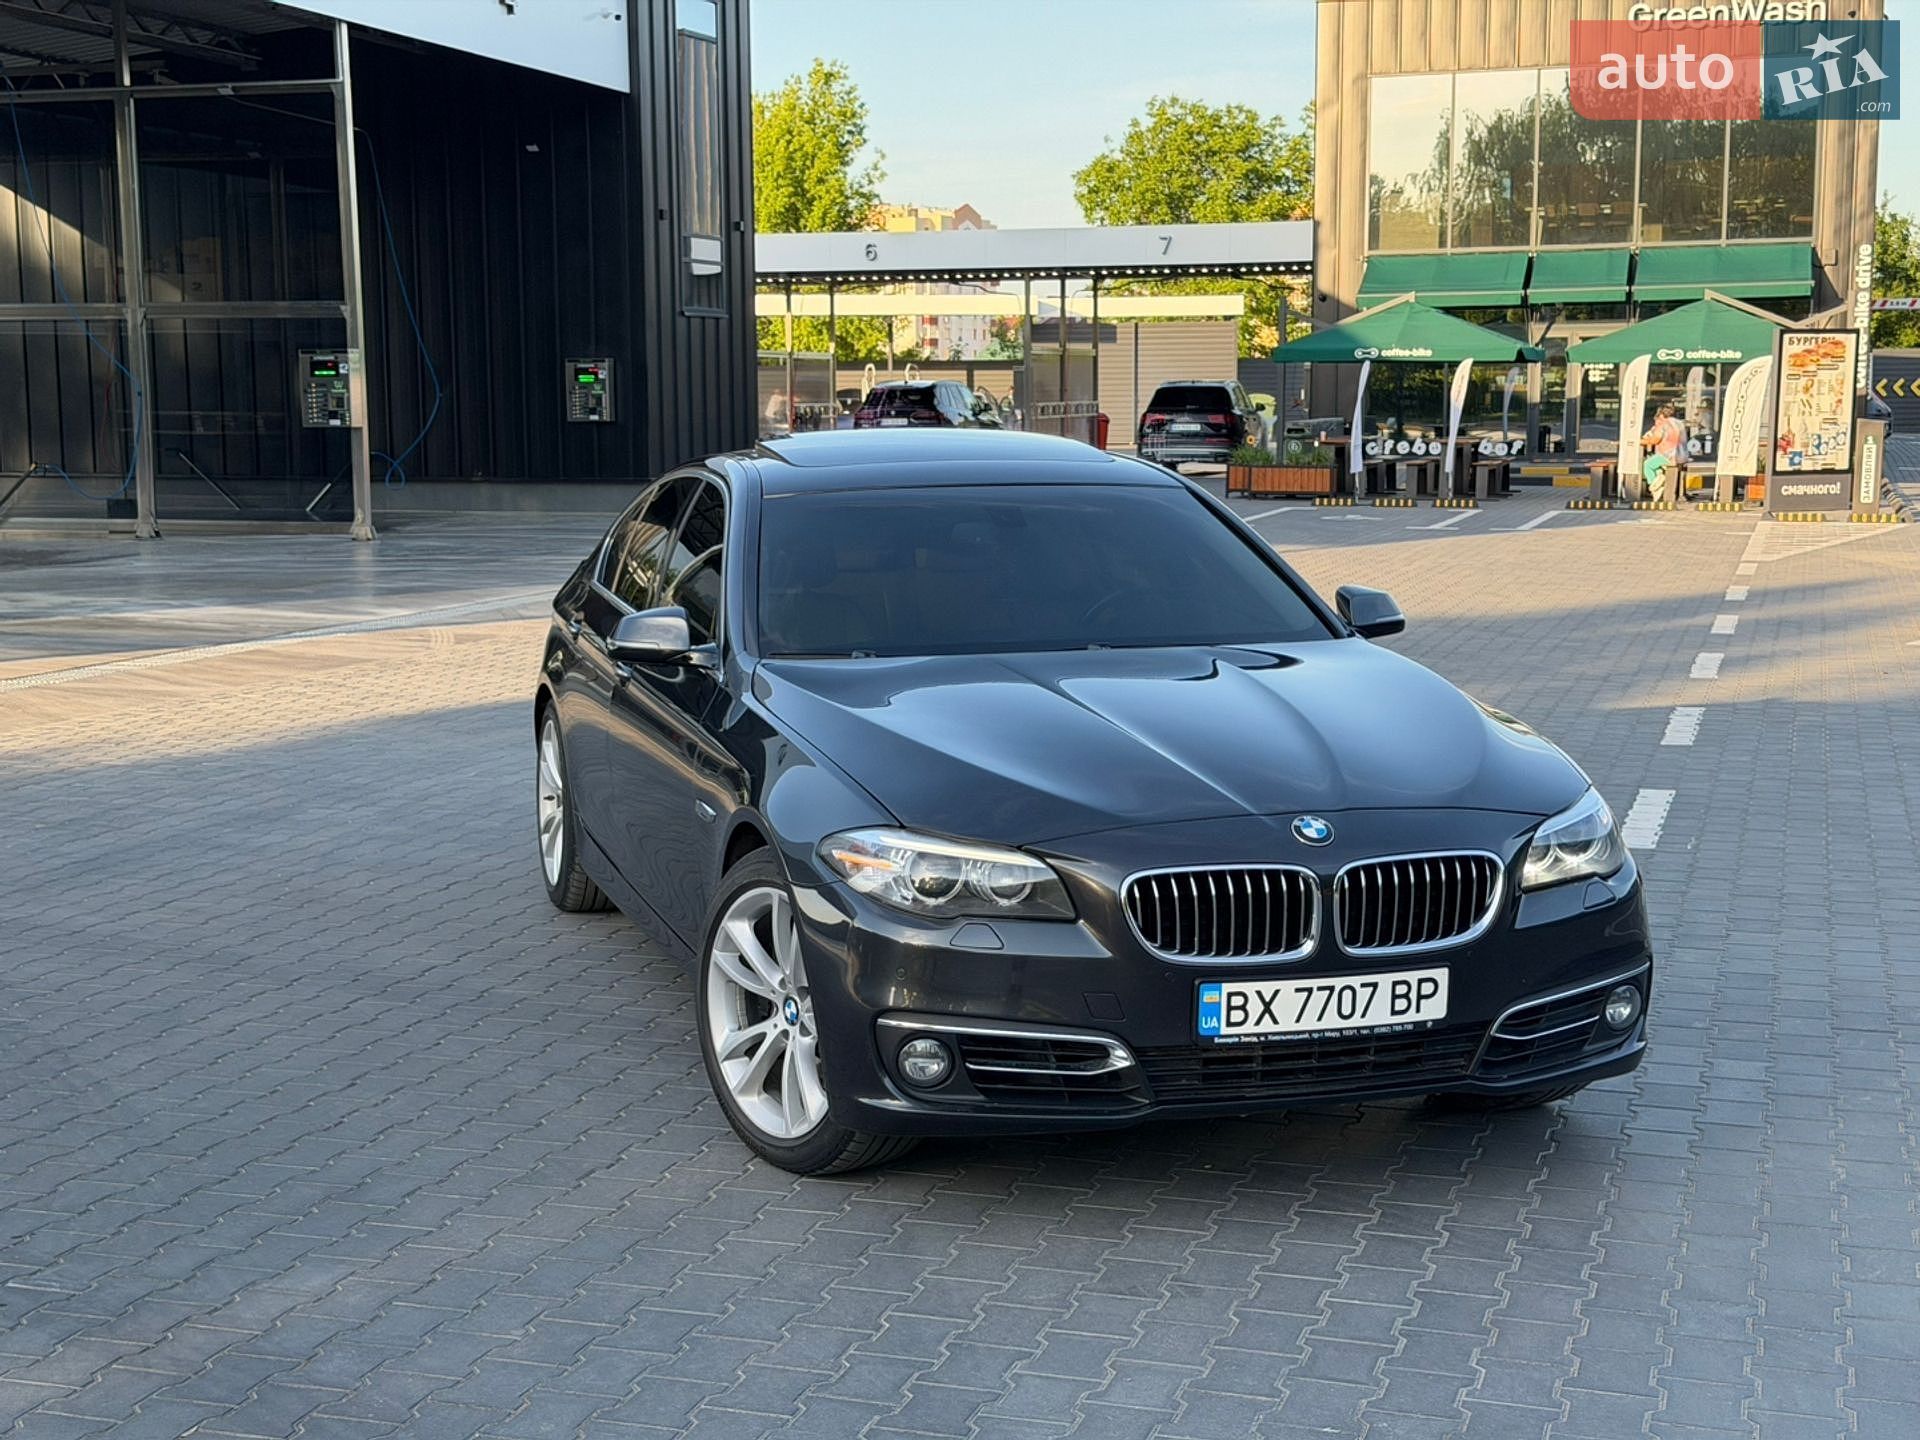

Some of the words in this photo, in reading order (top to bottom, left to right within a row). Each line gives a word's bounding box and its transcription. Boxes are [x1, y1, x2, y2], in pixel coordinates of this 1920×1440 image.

[1628, 0, 1826, 30] GreenWash
[864, 243, 878, 262] 6
[1158, 235, 1173, 255] 7
[1855, 244, 1872, 289] drive
[1788, 336, 1836, 346] БУРГЕР
[1685, 349, 1743, 359] coffee-bike
[1781, 482, 1840, 495] смачного!
[1225, 988, 1281, 1028] BX
[1293, 981, 1379, 1024] 7707
[1390, 977, 1439, 1017] BP
[1202, 1016, 1218, 1029] UA
